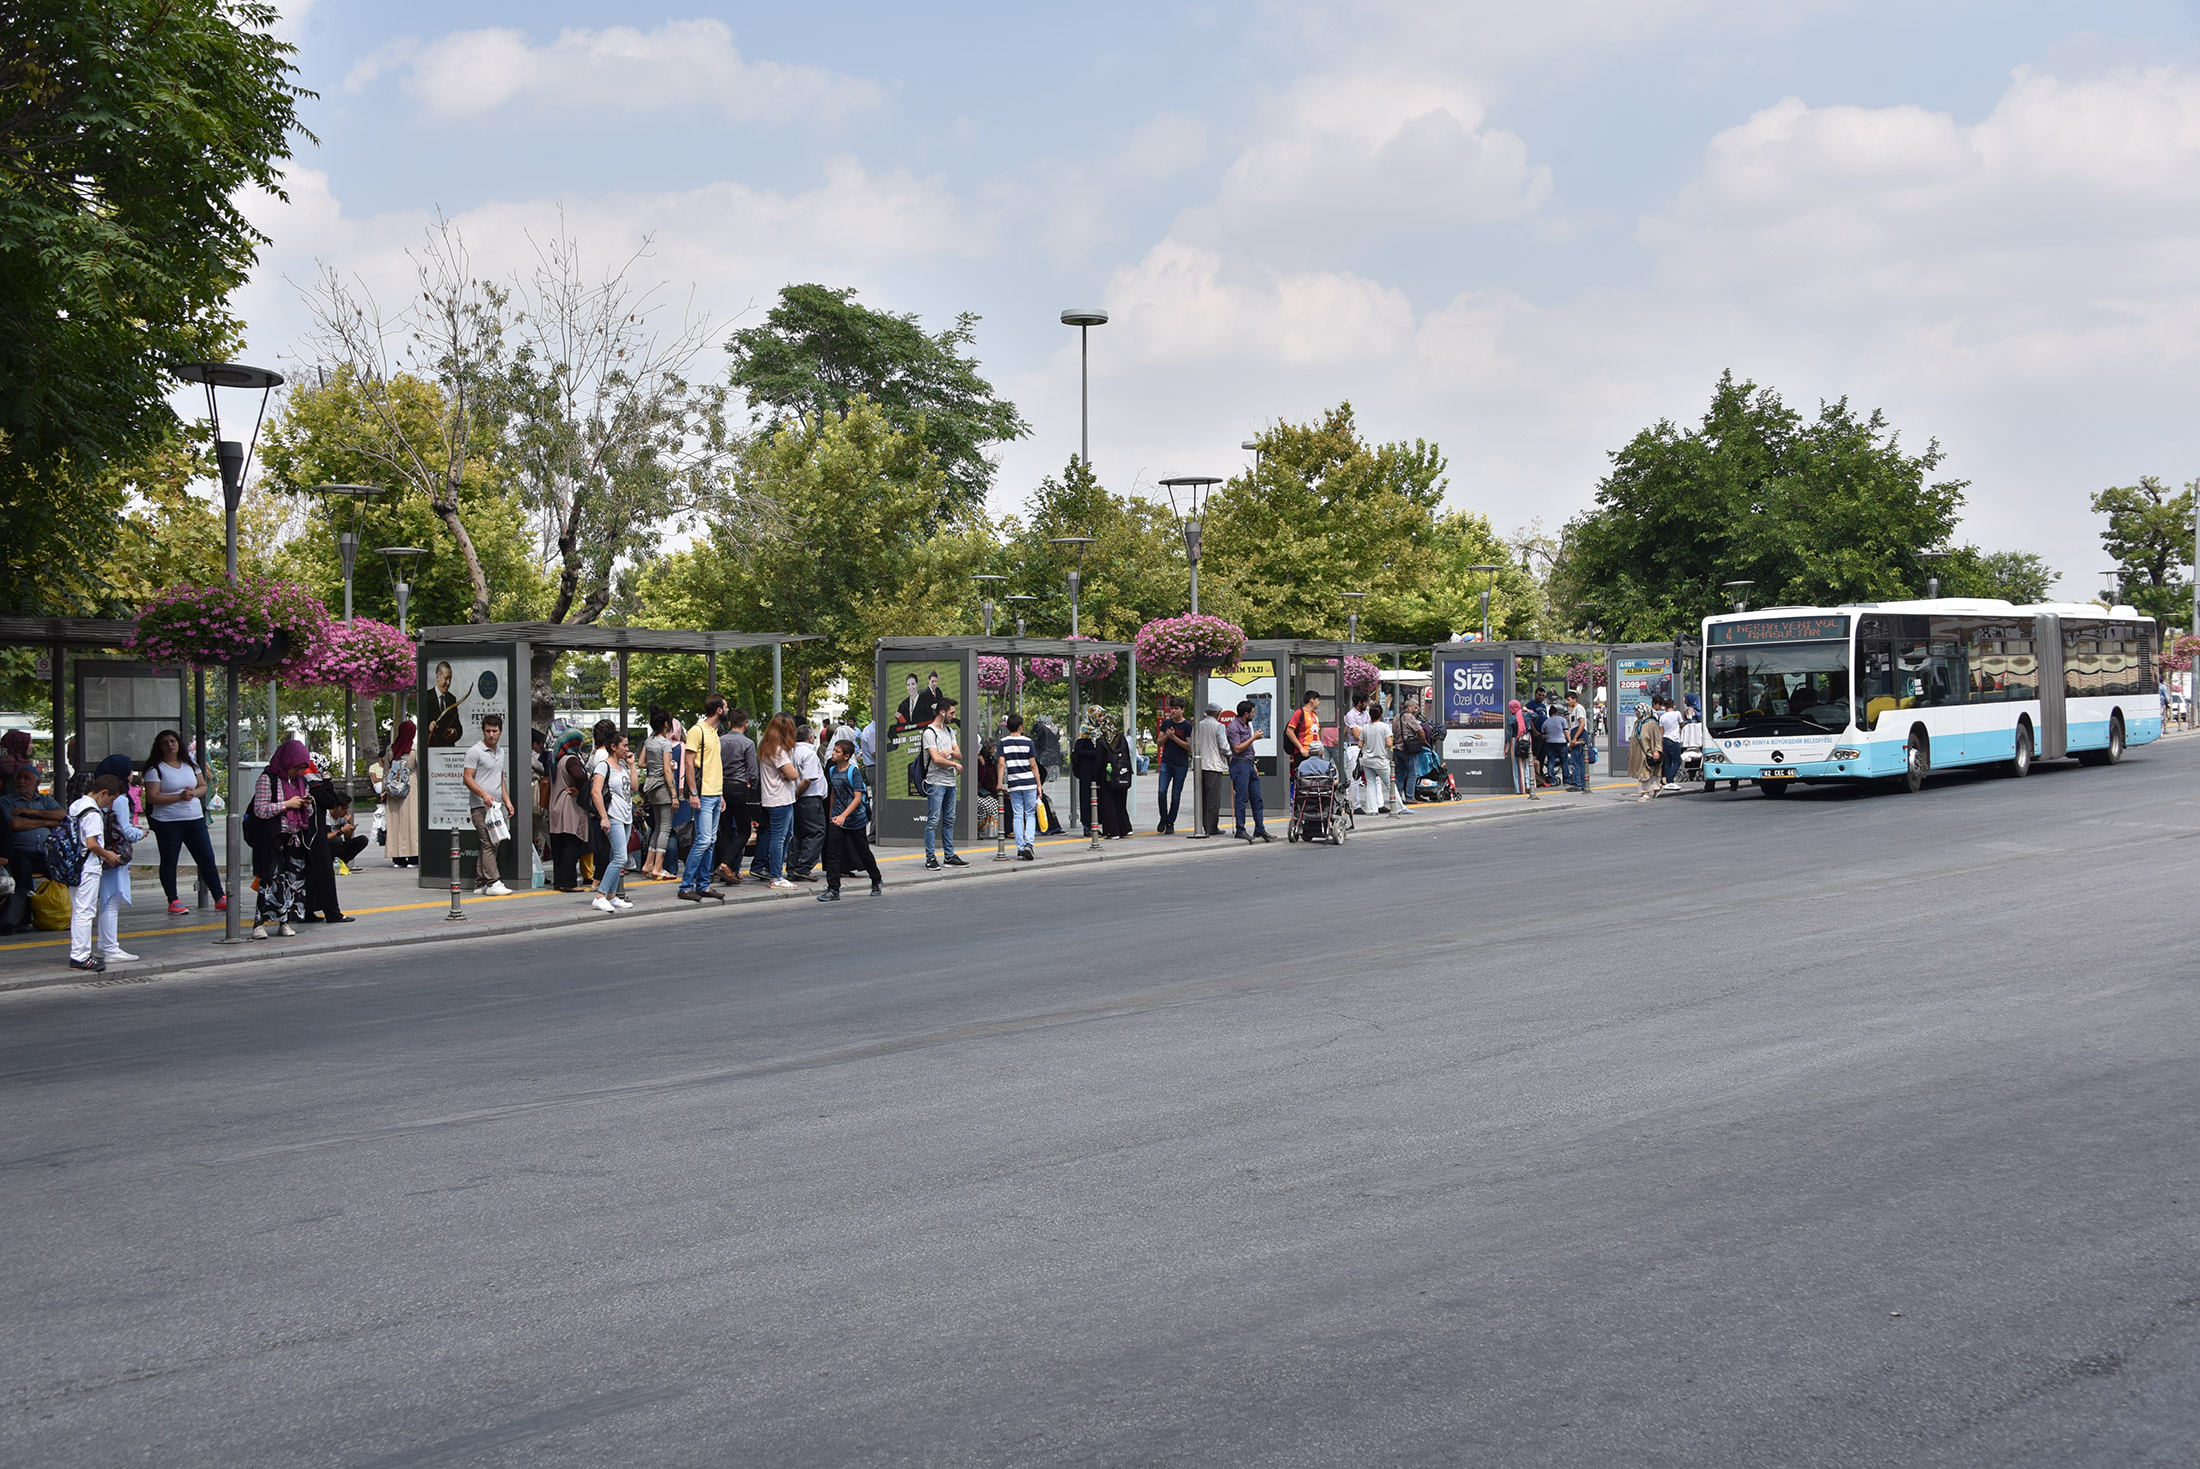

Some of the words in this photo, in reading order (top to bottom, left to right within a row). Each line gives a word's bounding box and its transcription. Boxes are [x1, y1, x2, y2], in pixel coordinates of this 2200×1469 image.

[1453, 668, 1494, 691] Size
[1453, 691, 1472, 706] Özel
[1474, 692, 1495, 706] Okul
[1771, 738, 1803, 746] BÜYÜKŞEHİR
